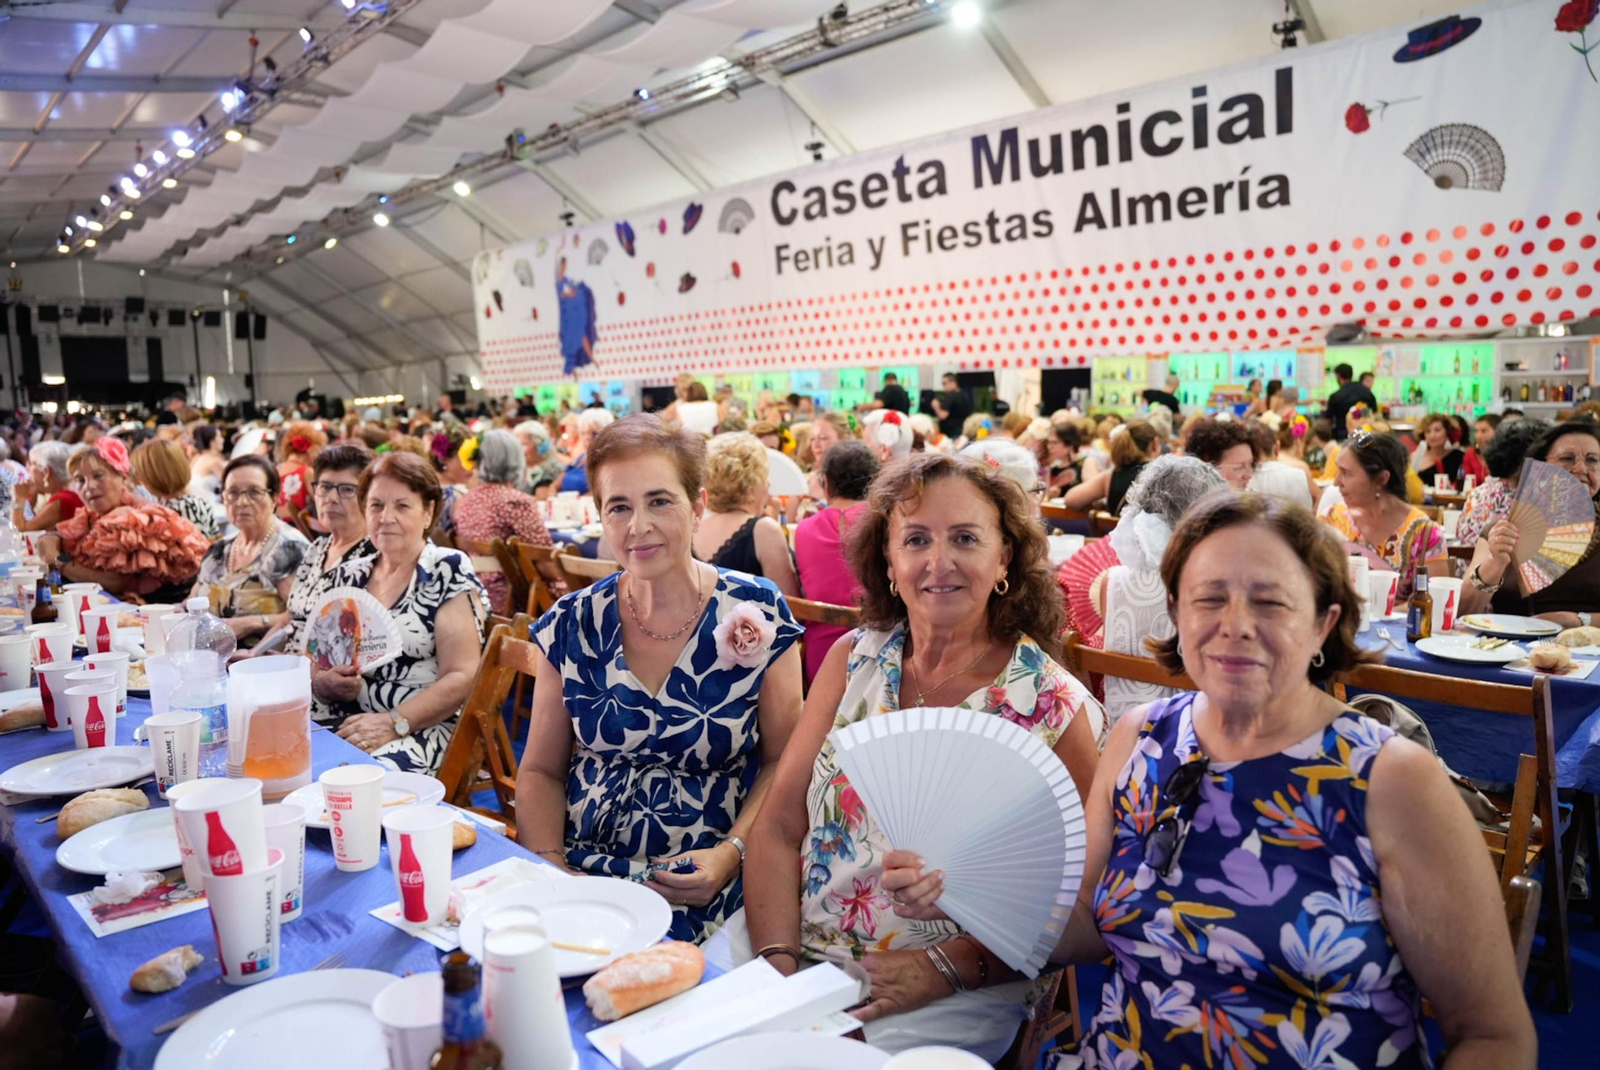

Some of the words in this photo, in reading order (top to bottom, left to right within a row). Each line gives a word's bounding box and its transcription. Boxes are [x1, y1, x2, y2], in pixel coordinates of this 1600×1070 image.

[771, 155, 947, 226] Caseta
[971, 66, 1294, 189] Municial
[775, 237, 855, 275] Feria
[868, 237, 886, 270] y
[900, 209, 1054, 258] Fiestas
[1073, 165, 1292, 234] Almería
